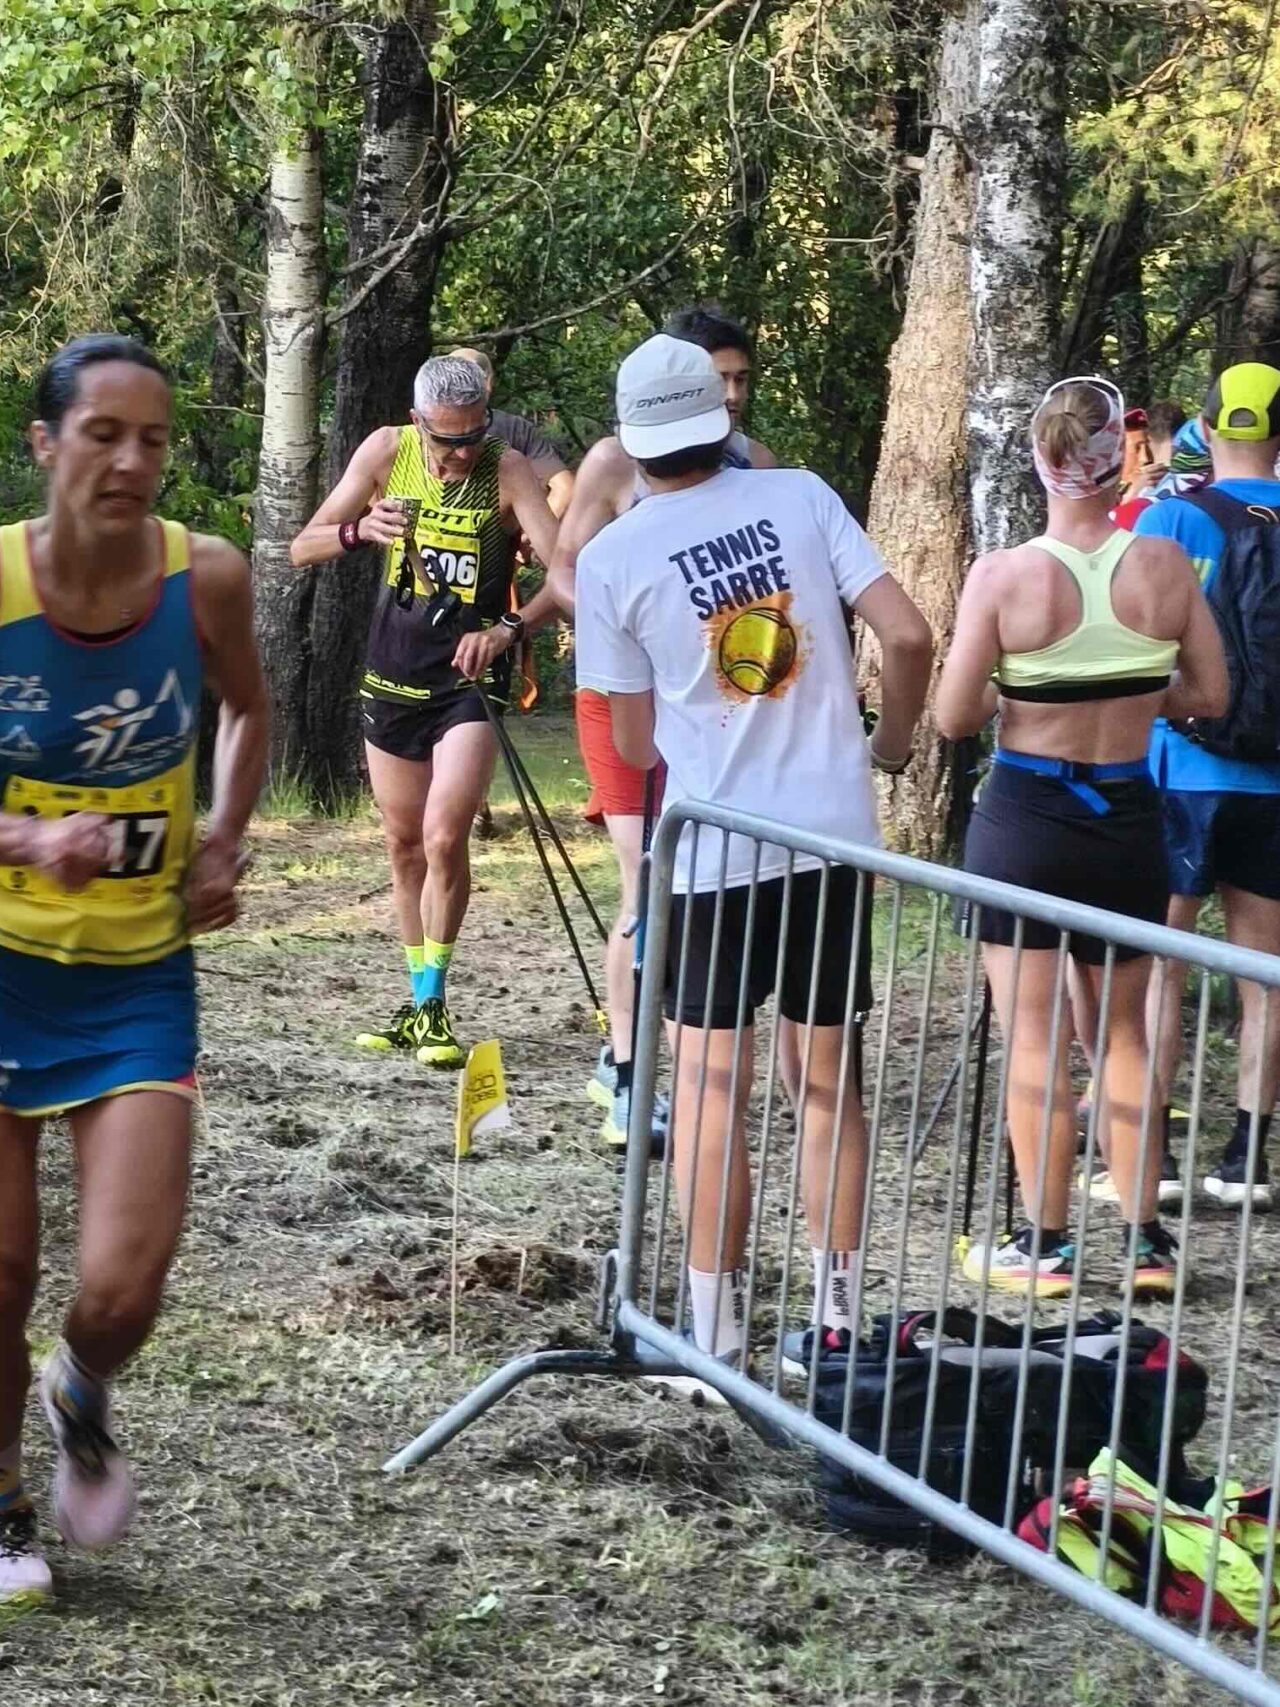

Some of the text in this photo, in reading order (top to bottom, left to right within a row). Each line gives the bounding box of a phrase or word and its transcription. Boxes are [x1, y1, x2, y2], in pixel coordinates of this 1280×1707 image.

[636, 387, 705, 408] DYNAFIT
[668, 519, 781, 585] TENNIS
[689, 555, 791, 621] SARRE
[109, 817, 168, 872] 17
